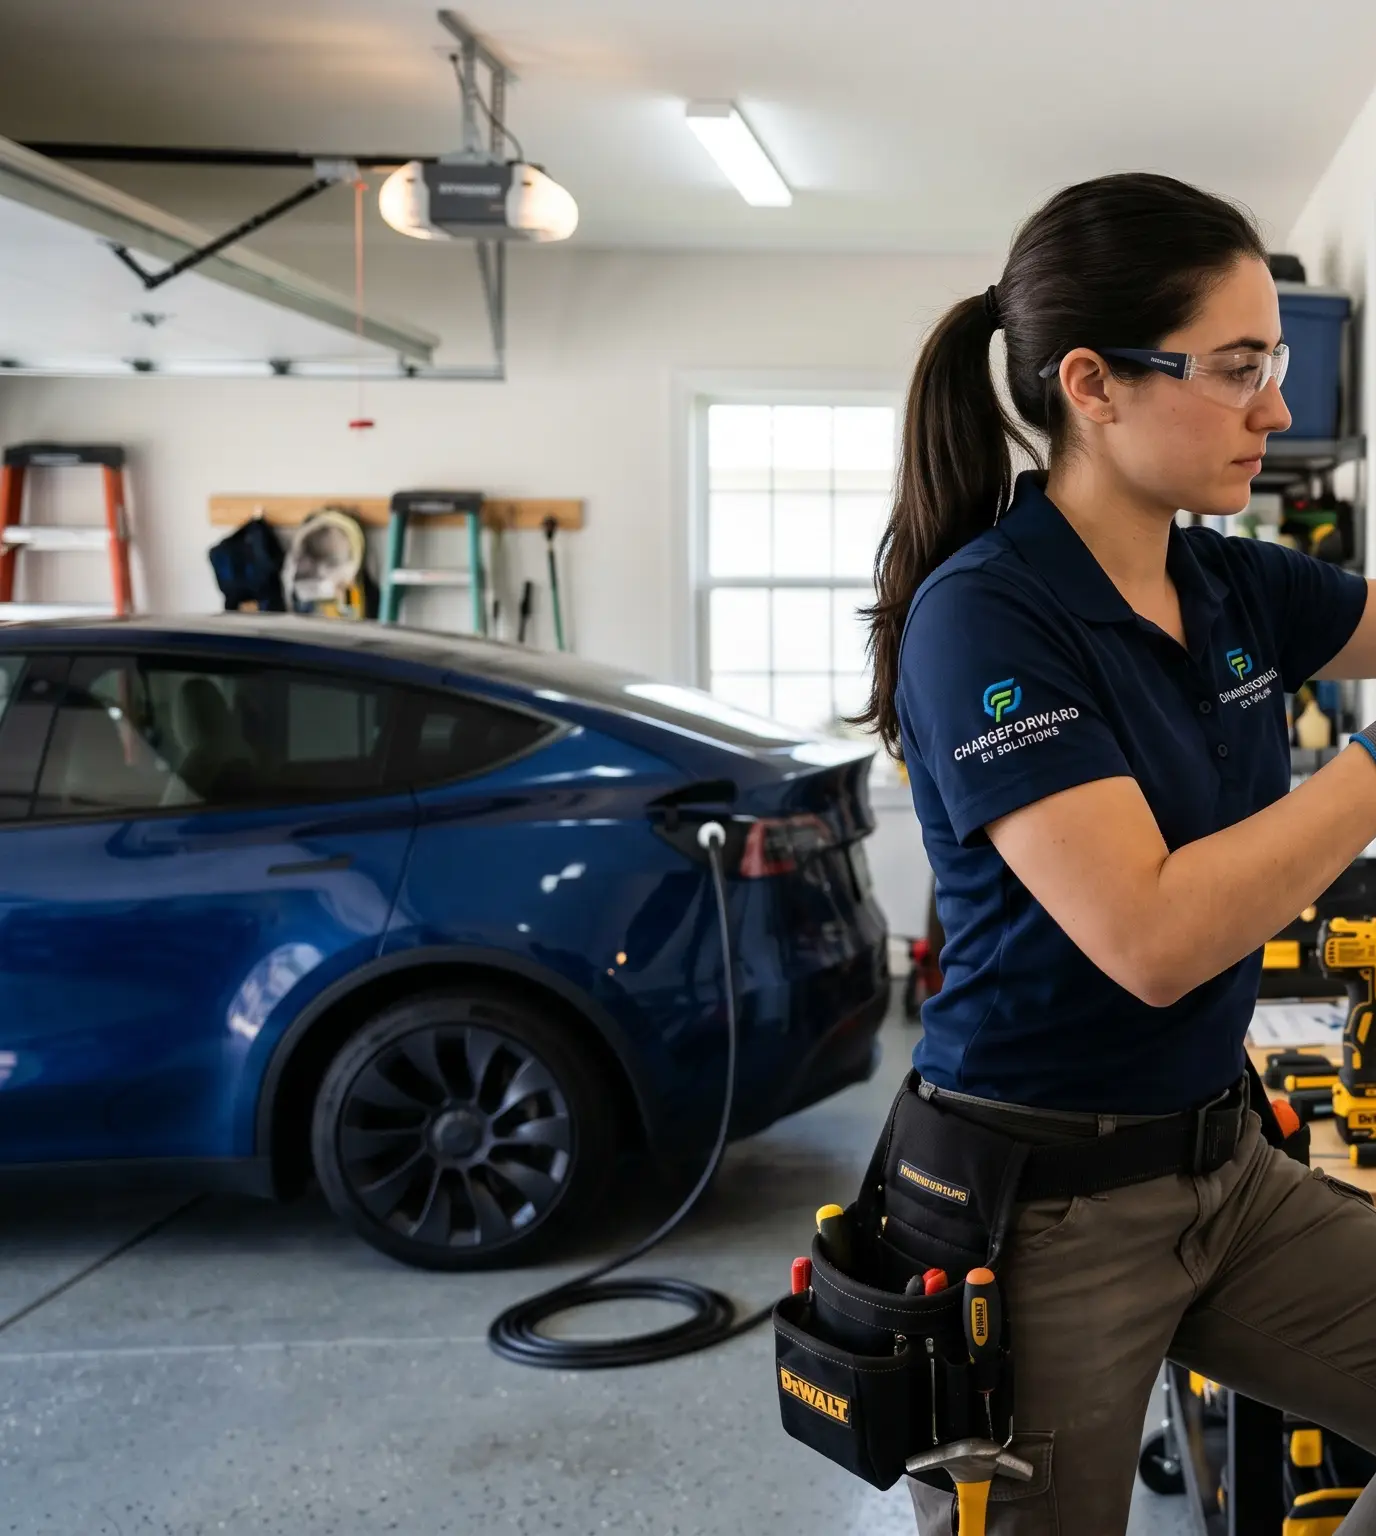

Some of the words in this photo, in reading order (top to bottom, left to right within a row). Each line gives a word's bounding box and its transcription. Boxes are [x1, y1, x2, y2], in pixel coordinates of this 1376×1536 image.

[954, 707, 1080, 761] CHARGEFORWARD
[980, 751, 994, 763] EV
[996, 726, 1060, 756] SOLUTIONS
